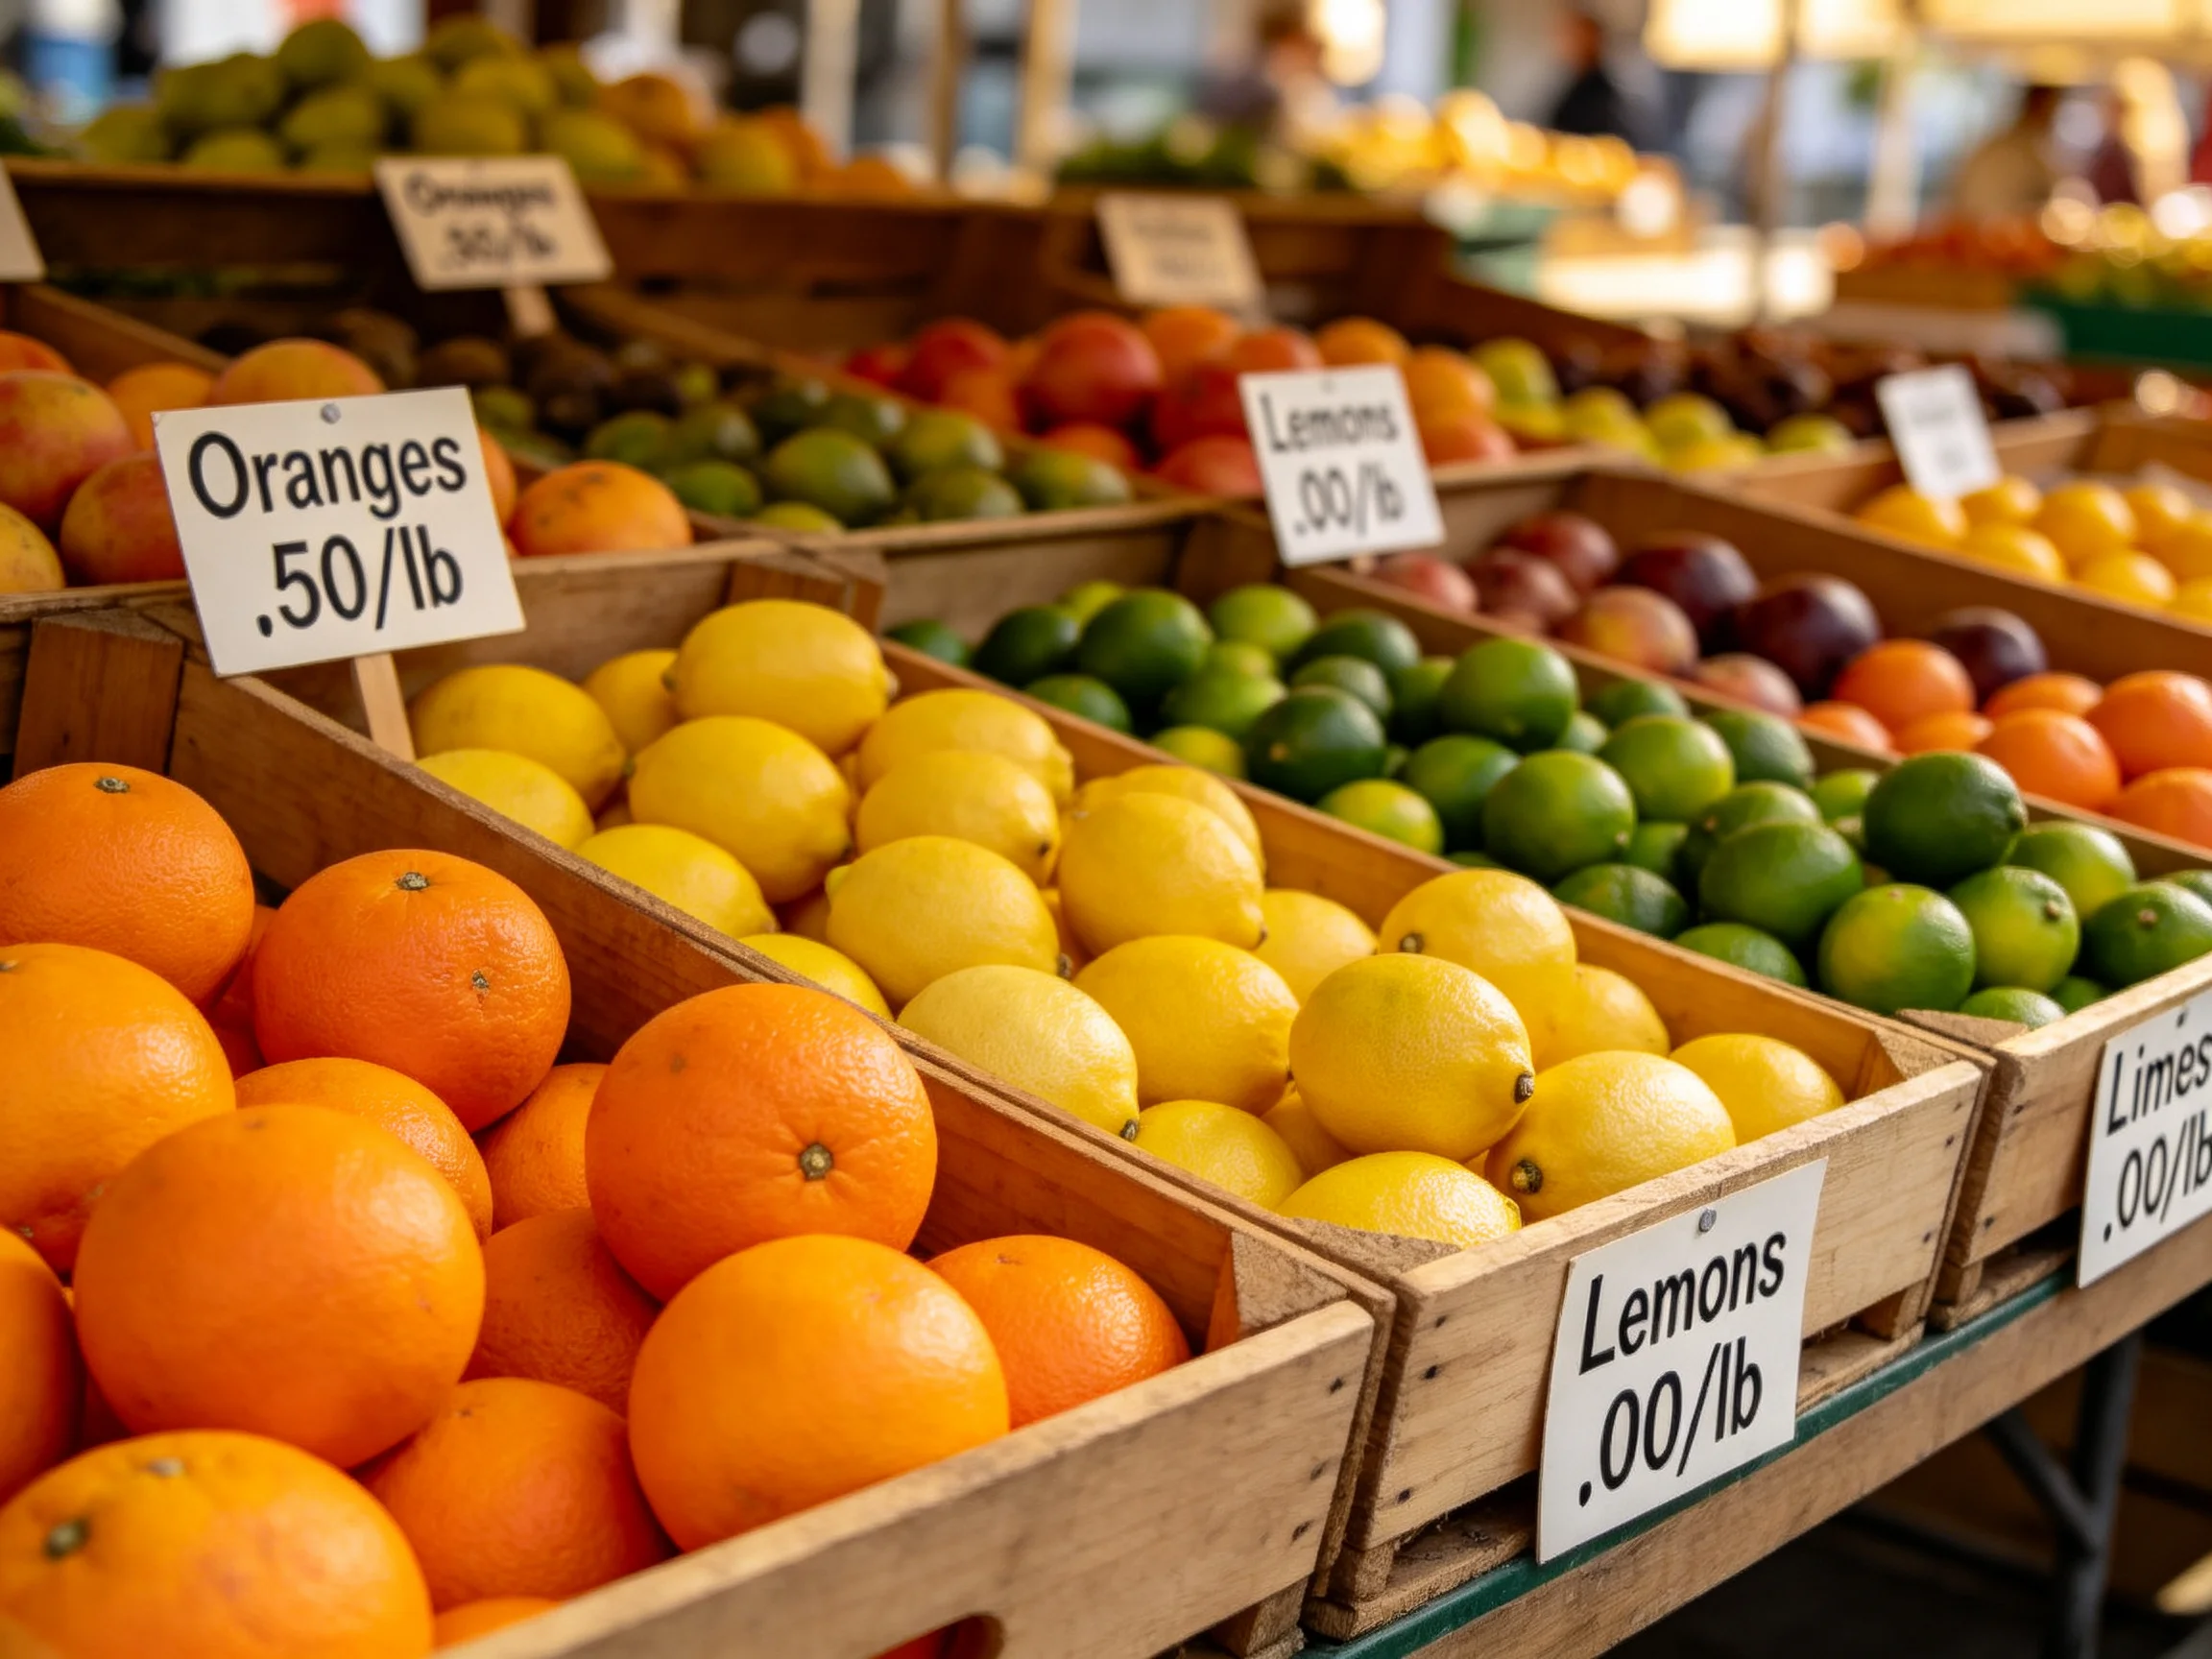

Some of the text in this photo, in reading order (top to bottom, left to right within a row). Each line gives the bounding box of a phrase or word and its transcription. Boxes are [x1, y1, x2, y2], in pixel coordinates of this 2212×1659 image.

[187, 430, 468, 519] Oranges
[1260, 392, 1401, 453] Lemons
[1293, 461, 1405, 537] .00/lb
[256, 524, 463, 637] .50/lb
[2106, 1032, 2212, 1137] Limes
[2103, 1109, 2212, 1242] .00/lb
[1579, 1231, 1787, 1376] Lemons
[1578, 1335, 1763, 1508] .00/lb
